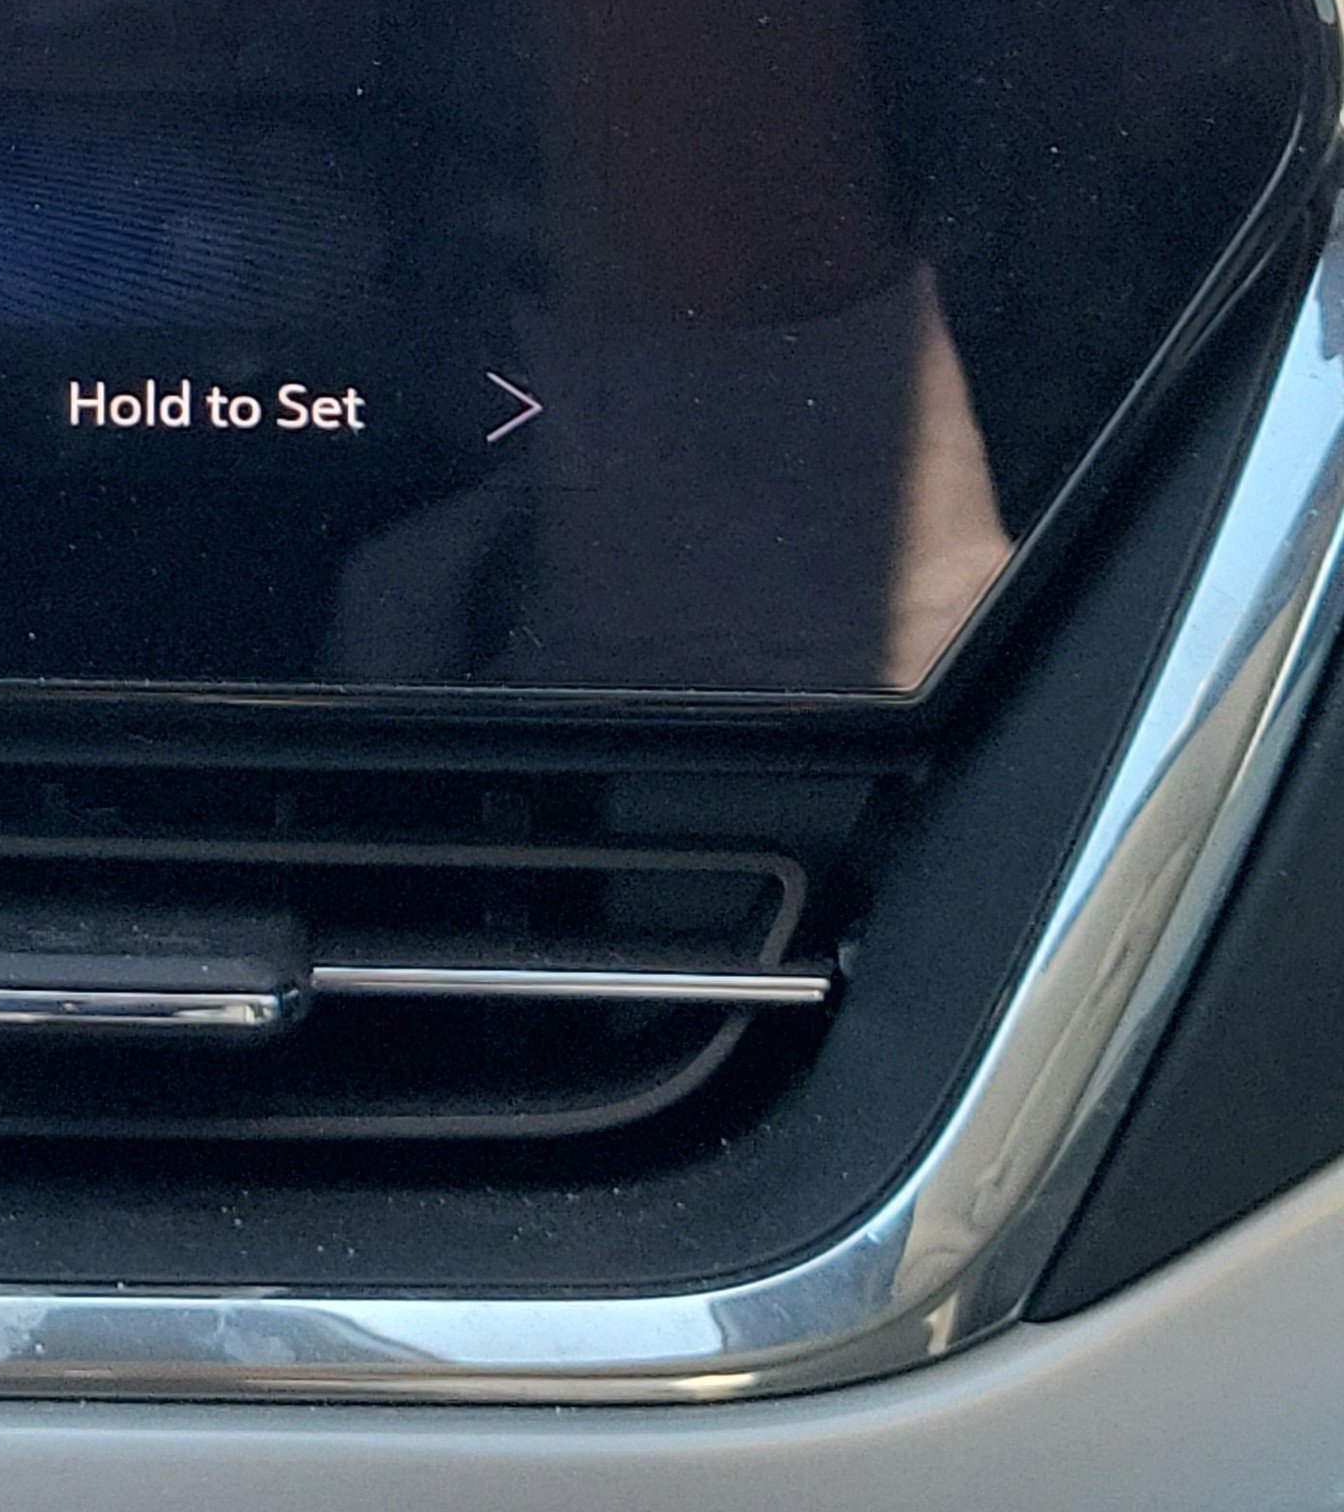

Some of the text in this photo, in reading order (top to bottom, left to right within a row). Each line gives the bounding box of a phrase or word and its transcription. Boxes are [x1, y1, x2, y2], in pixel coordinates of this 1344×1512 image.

[69, 378, 366, 430] Hold to Set
